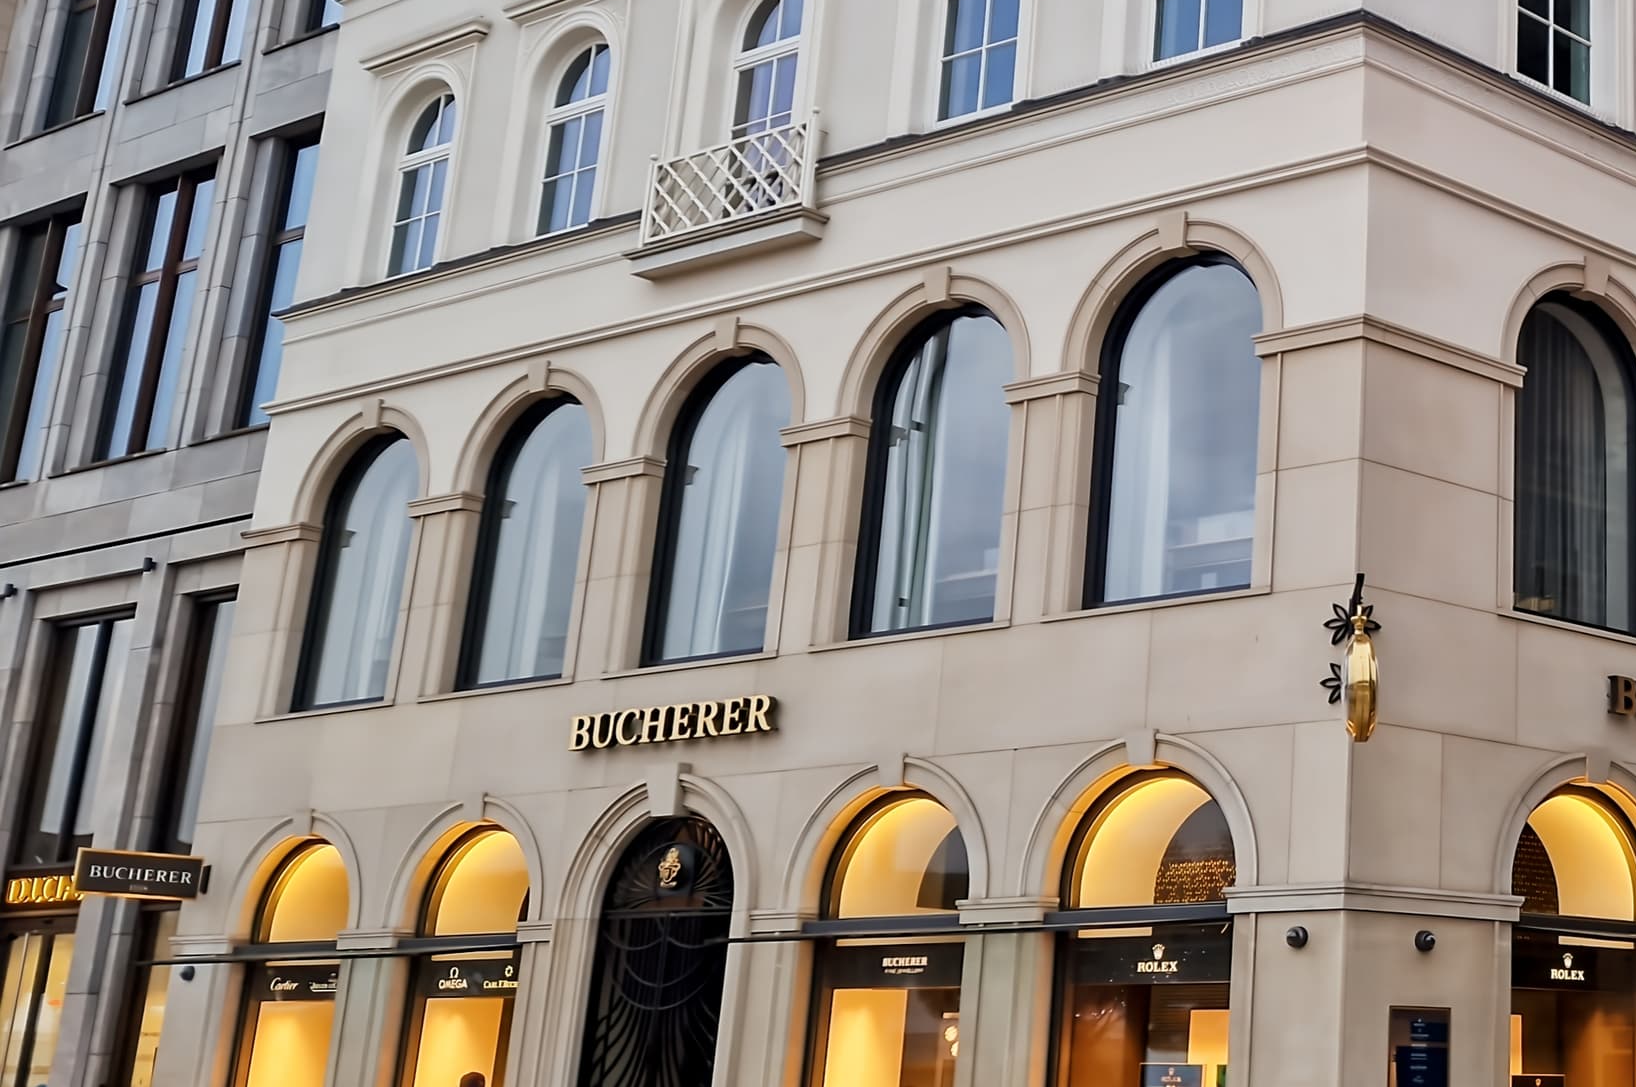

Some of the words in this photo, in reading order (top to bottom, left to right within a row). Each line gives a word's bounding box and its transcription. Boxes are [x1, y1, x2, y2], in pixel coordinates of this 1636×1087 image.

[568, 694, 775, 752] BUCHERER
[89, 865, 192, 885] BUCHERER
[1137, 961, 1178, 973] ROLEX
[1550, 968, 1585, 981] ROLEX
